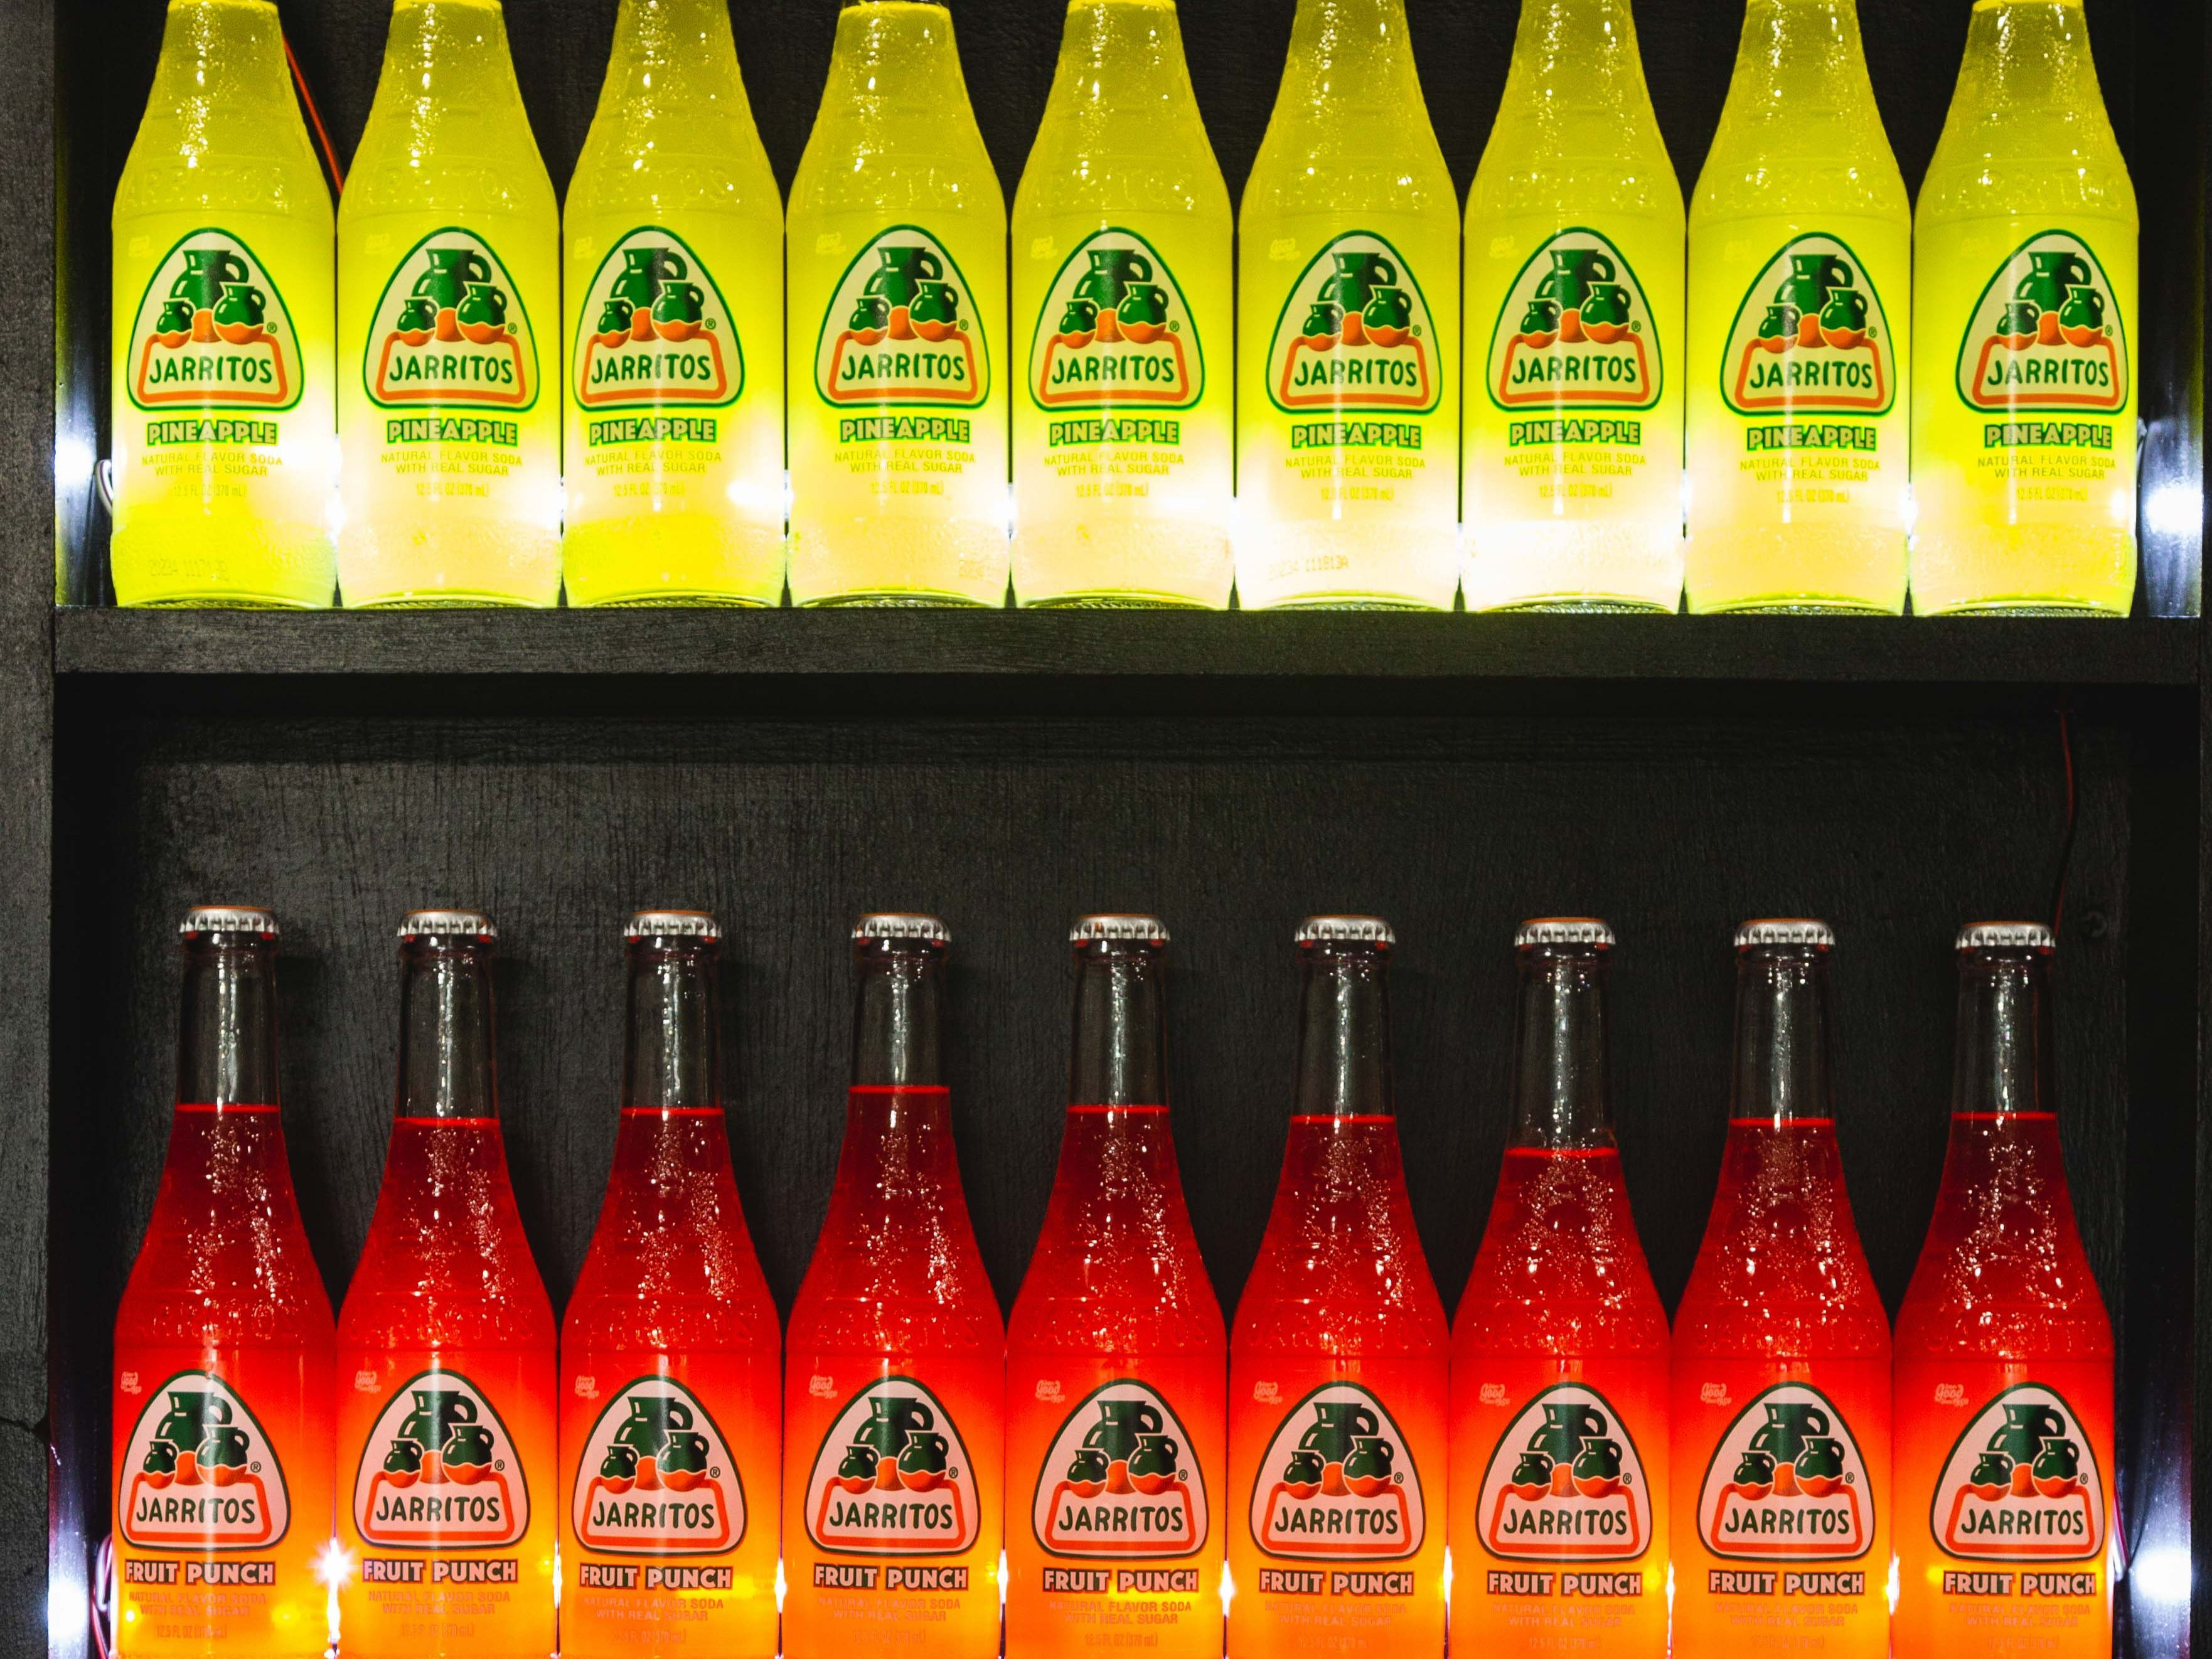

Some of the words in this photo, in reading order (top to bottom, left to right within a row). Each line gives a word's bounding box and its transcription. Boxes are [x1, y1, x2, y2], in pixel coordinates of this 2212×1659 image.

[150, 355, 272, 384] JARRITOS
[390, 355, 513, 383] JARRITOS
[591, 353, 711, 383] JARRITOS
[842, 353, 964, 381] JARRITOS
[1052, 355, 1175, 383] JARRITOS
[1295, 358, 1417, 387] JARRITOS
[1512, 355, 1636, 383] JARRITOS
[1750, 360, 1873, 389] JARRITOS
[1987, 358, 2109, 387] JARRITOS
[147, 419, 277, 445] PINEAPPLE
[387, 419, 518, 447] PINEAPPLE
[589, 418, 717, 447] PINEAPPLE
[840, 417, 970, 444] PINEAPPLE
[1049, 419, 1180, 447] PINEAPPLE
[1291, 422, 1421, 451] PINEAPPLE
[1510, 419, 1641, 447] PINEAPPLE
[1746, 424, 1877, 452] PINEAPPLE
[1984, 422, 2113, 450] PINEAPPLE
[141, 452, 190, 466] NATURAL
[251, 453, 282, 466] SODA
[396, 463, 426, 474] WITH
[468, 464, 509, 476] SUGAR
[440, 451, 488, 461] FLAVOR
[493, 453, 522, 466] SODA
[584, 452, 629, 466] NATURAL
[688, 451, 722, 462] SODA
[596, 465, 623, 476] WITH
[663, 463, 707, 474] SUGAR
[850, 462, 880, 473] WITH
[887, 461, 919, 471] REAL
[922, 461, 963, 474] SUGAR
[895, 449, 941, 459] FLAVOR
[946, 451, 975, 463] SODA
[1044, 452, 1093, 466] NATURAL
[1152, 452, 1184, 464] SODA
[1345, 456, 1392, 465] FLAVOR
[1397, 456, 1426, 468] SODA
[1504, 452, 1556, 466] NATURAL
[1563, 452, 1611, 462] FLAVOR
[1616, 453, 1647, 465] SODA
[1800, 457, 1848, 467] FLAVOR
[1852, 457, 1881, 471] SODA
[1977, 456, 2033, 467] NATURAL
[2041, 456, 2086, 466] FLAVOR
[2090, 457, 2117, 469] SODA
[156, 464, 184, 476] WITH
[225, 464, 268, 476] SUGAR
[1057, 464, 1086, 476] WITH
[1126, 464, 1170, 475] SUGAR
[1301, 468, 1331, 479] WITH
[1373, 468, 1413, 479] SUGAR
[1519, 465, 1549, 476] WITH
[1591, 464, 1632, 476] SUGAR
[1755, 470, 1786, 481] WITH
[1793, 469, 1825, 480] REAL
[1829, 469, 1868, 482] SUGAR
[2033, 468, 2063, 478] REAL
[2069, 468, 2106, 480] SUGAR
[136, 1497, 256, 1524] JARRITOS
[377, 1496, 500, 1523] JARRITOS
[593, 1502, 715, 1529] JARRITOS
[830, 1502, 953, 1530] JARRITOS
[1059, 1505, 1183, 1534] JARRITOS
[1274, 1508, 1398, 1535] JARRITOS
[1504, 1508, 1627, 1536] JARRITOS
[1726, 1508, 1850, 1535] JARRITOS
[1961, 1509, 2083, 1536] JARRITOS
[125, 1559, 180, 1586] FRUIT
[185, 1560, 275, 1586] PUNCH
[362, 1558, 427, 1584] FRUIT
[432, 1559, 518, 1584] PUNCH
[579, 1562, 640, 1590] FRUIT
[644, 1566, 733, 1591] PUNCH
[813, 1562, 880, 1590] FRUIT
[885, 1566, 970, 1591] PUNCH
[1043, 1567, 1112, 1594] FRUIT
[1117, 1568, 1199, 1592] PUNCH
[1259, 1568, 1326, 1596] FRUIT
[1331, 1571, 1414, 1596] PUNCH
[1487, 1570, 1556, 1596] FRUIT
[1561, 1572, 1643, 1597] PUNCH
[1708, 1569, 1778, 1595] FRUIT
[1783, 1571, 1864, 1596] PUNCH
[1943, 1570, 2016, 1596] FRUIT
[2021, 1572, 2097, 1597] PUNCH
[1049, 1601, 1104, 1610] NATURAL
[1108, 1601, 1158, 1611] FLAVOR
[1162, 1601, 1192, 1611] SODA
[1064, 1613, 1096, 1623] WITH
[1099, 1614, 1133, 1624] REAL
[1137, 1614, 1178, 1624] SUGAR
